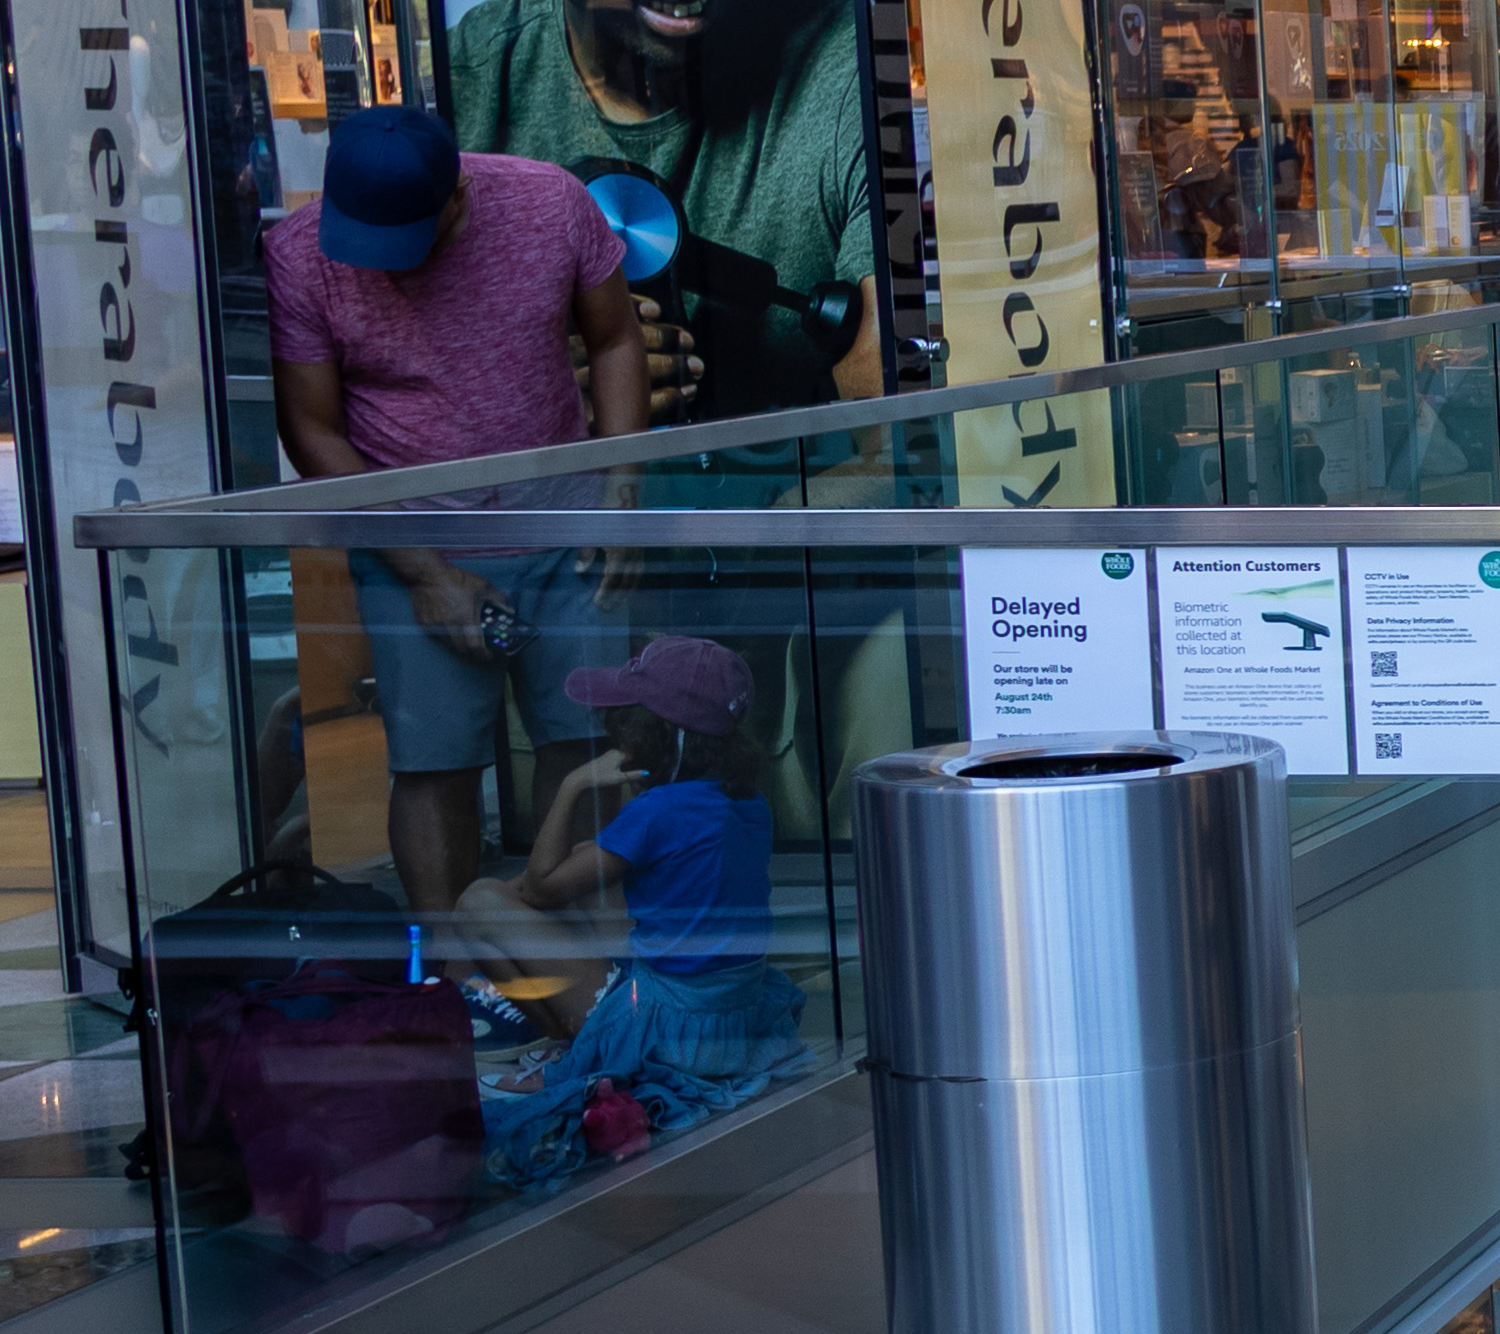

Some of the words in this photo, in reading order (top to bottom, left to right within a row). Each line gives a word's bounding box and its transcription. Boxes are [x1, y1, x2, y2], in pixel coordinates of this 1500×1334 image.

[1173, 560, 1241, 573] Attention
[1246, 560, 1321, 573] Customers
[991, 596, 1081, 618] Delayed
[1174, 602, 1229, 613] Biometric
[1175, 616, 1242, 627] information
[991, 619, 1088, 642] Opening
[1176, 630, 1227, 641] collected
[1230, 631, 1242, 641] at
[1177, 644, 1197, 656] this
[1201, 644, 1246, 656] location
[993, 664, 1012, 674] Our
[1014, 665, 1039, 674] store
[1041, 664, 1058, 674] will
[1060, 664, 1073, 674] be
[993, 676, 1033, 687] opening
[1036, 676, 1053, 686] late
[1056, 678, 1068, 686] on
[995, 692, 1027, 703] August
[1027, 692, 1053, 702] 24th
